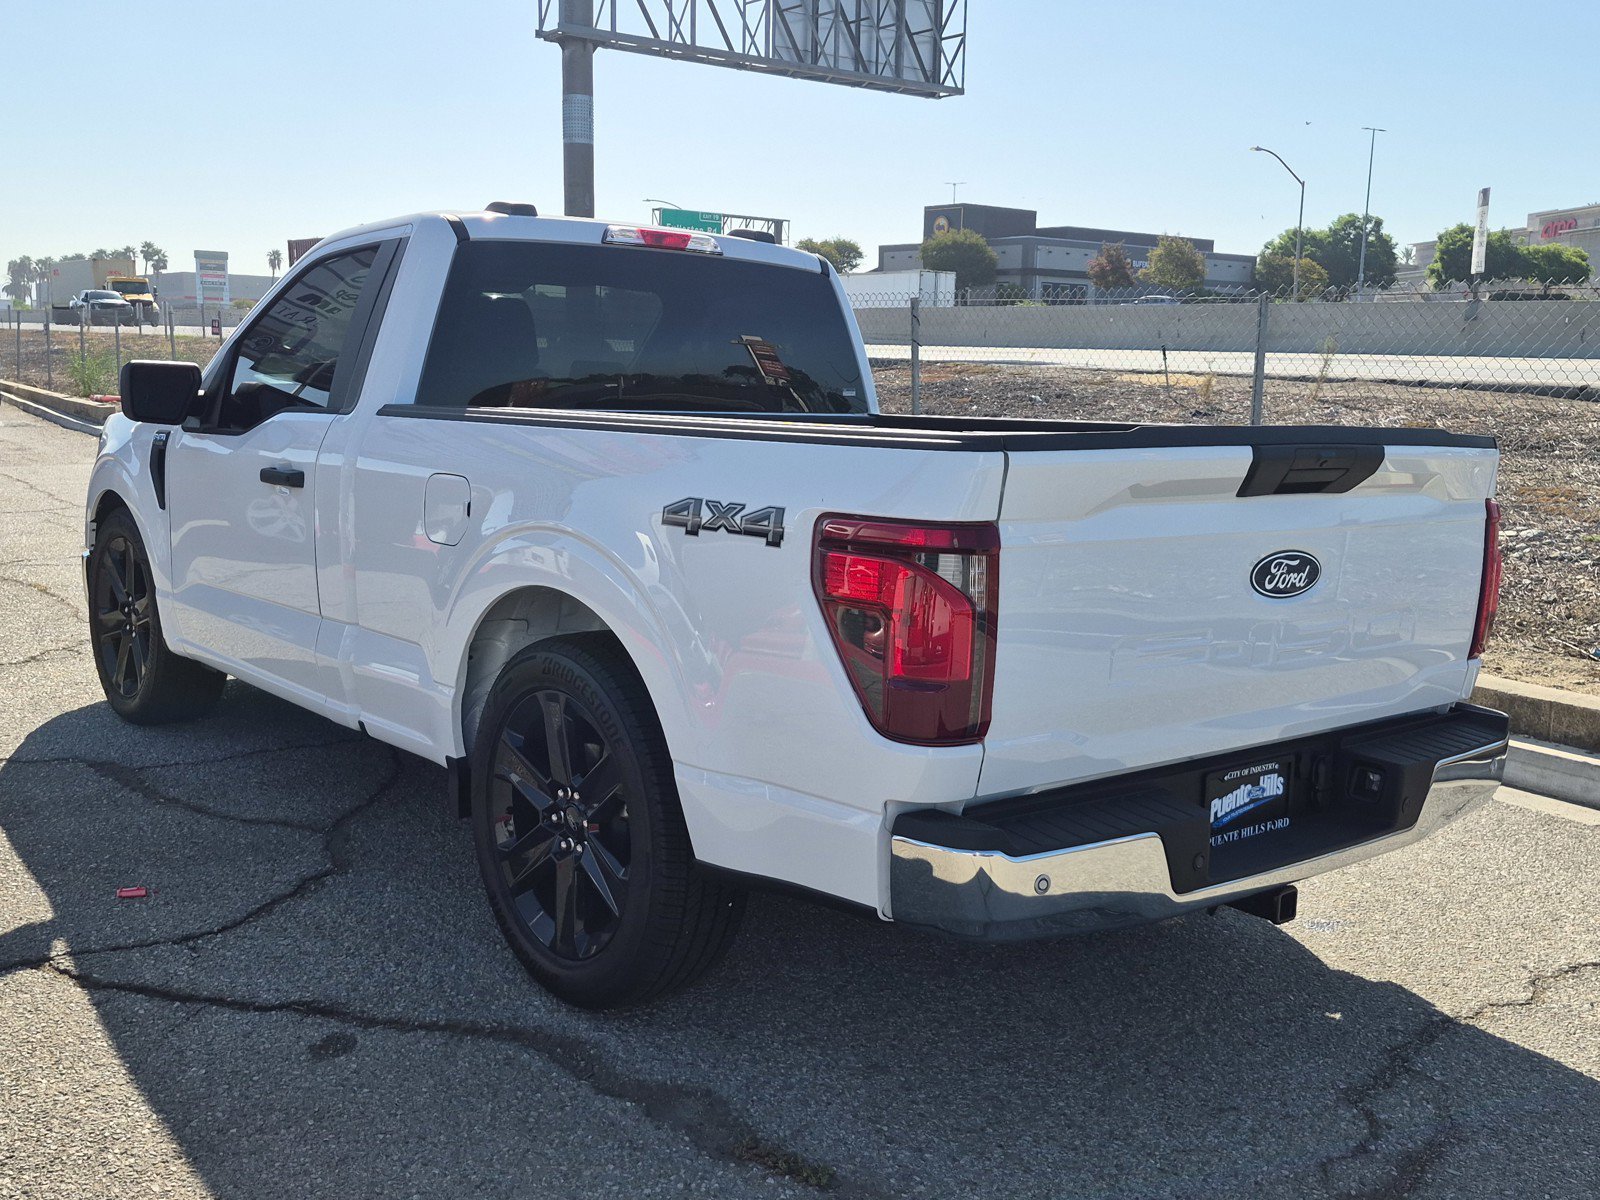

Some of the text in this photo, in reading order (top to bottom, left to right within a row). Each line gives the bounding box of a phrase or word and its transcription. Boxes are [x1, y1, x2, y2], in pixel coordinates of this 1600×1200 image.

[1264, 559, 1310, 590] Ford
[1227, 762, 1276, 780] CITY OF INDUSTRY
[1210, 783, 1252, 823] Puente
[1259, 773, 1284, 798] Hills
[1240, 823, 1266, 839] HILLS
[1266, 817, 1290, 832] FORD
